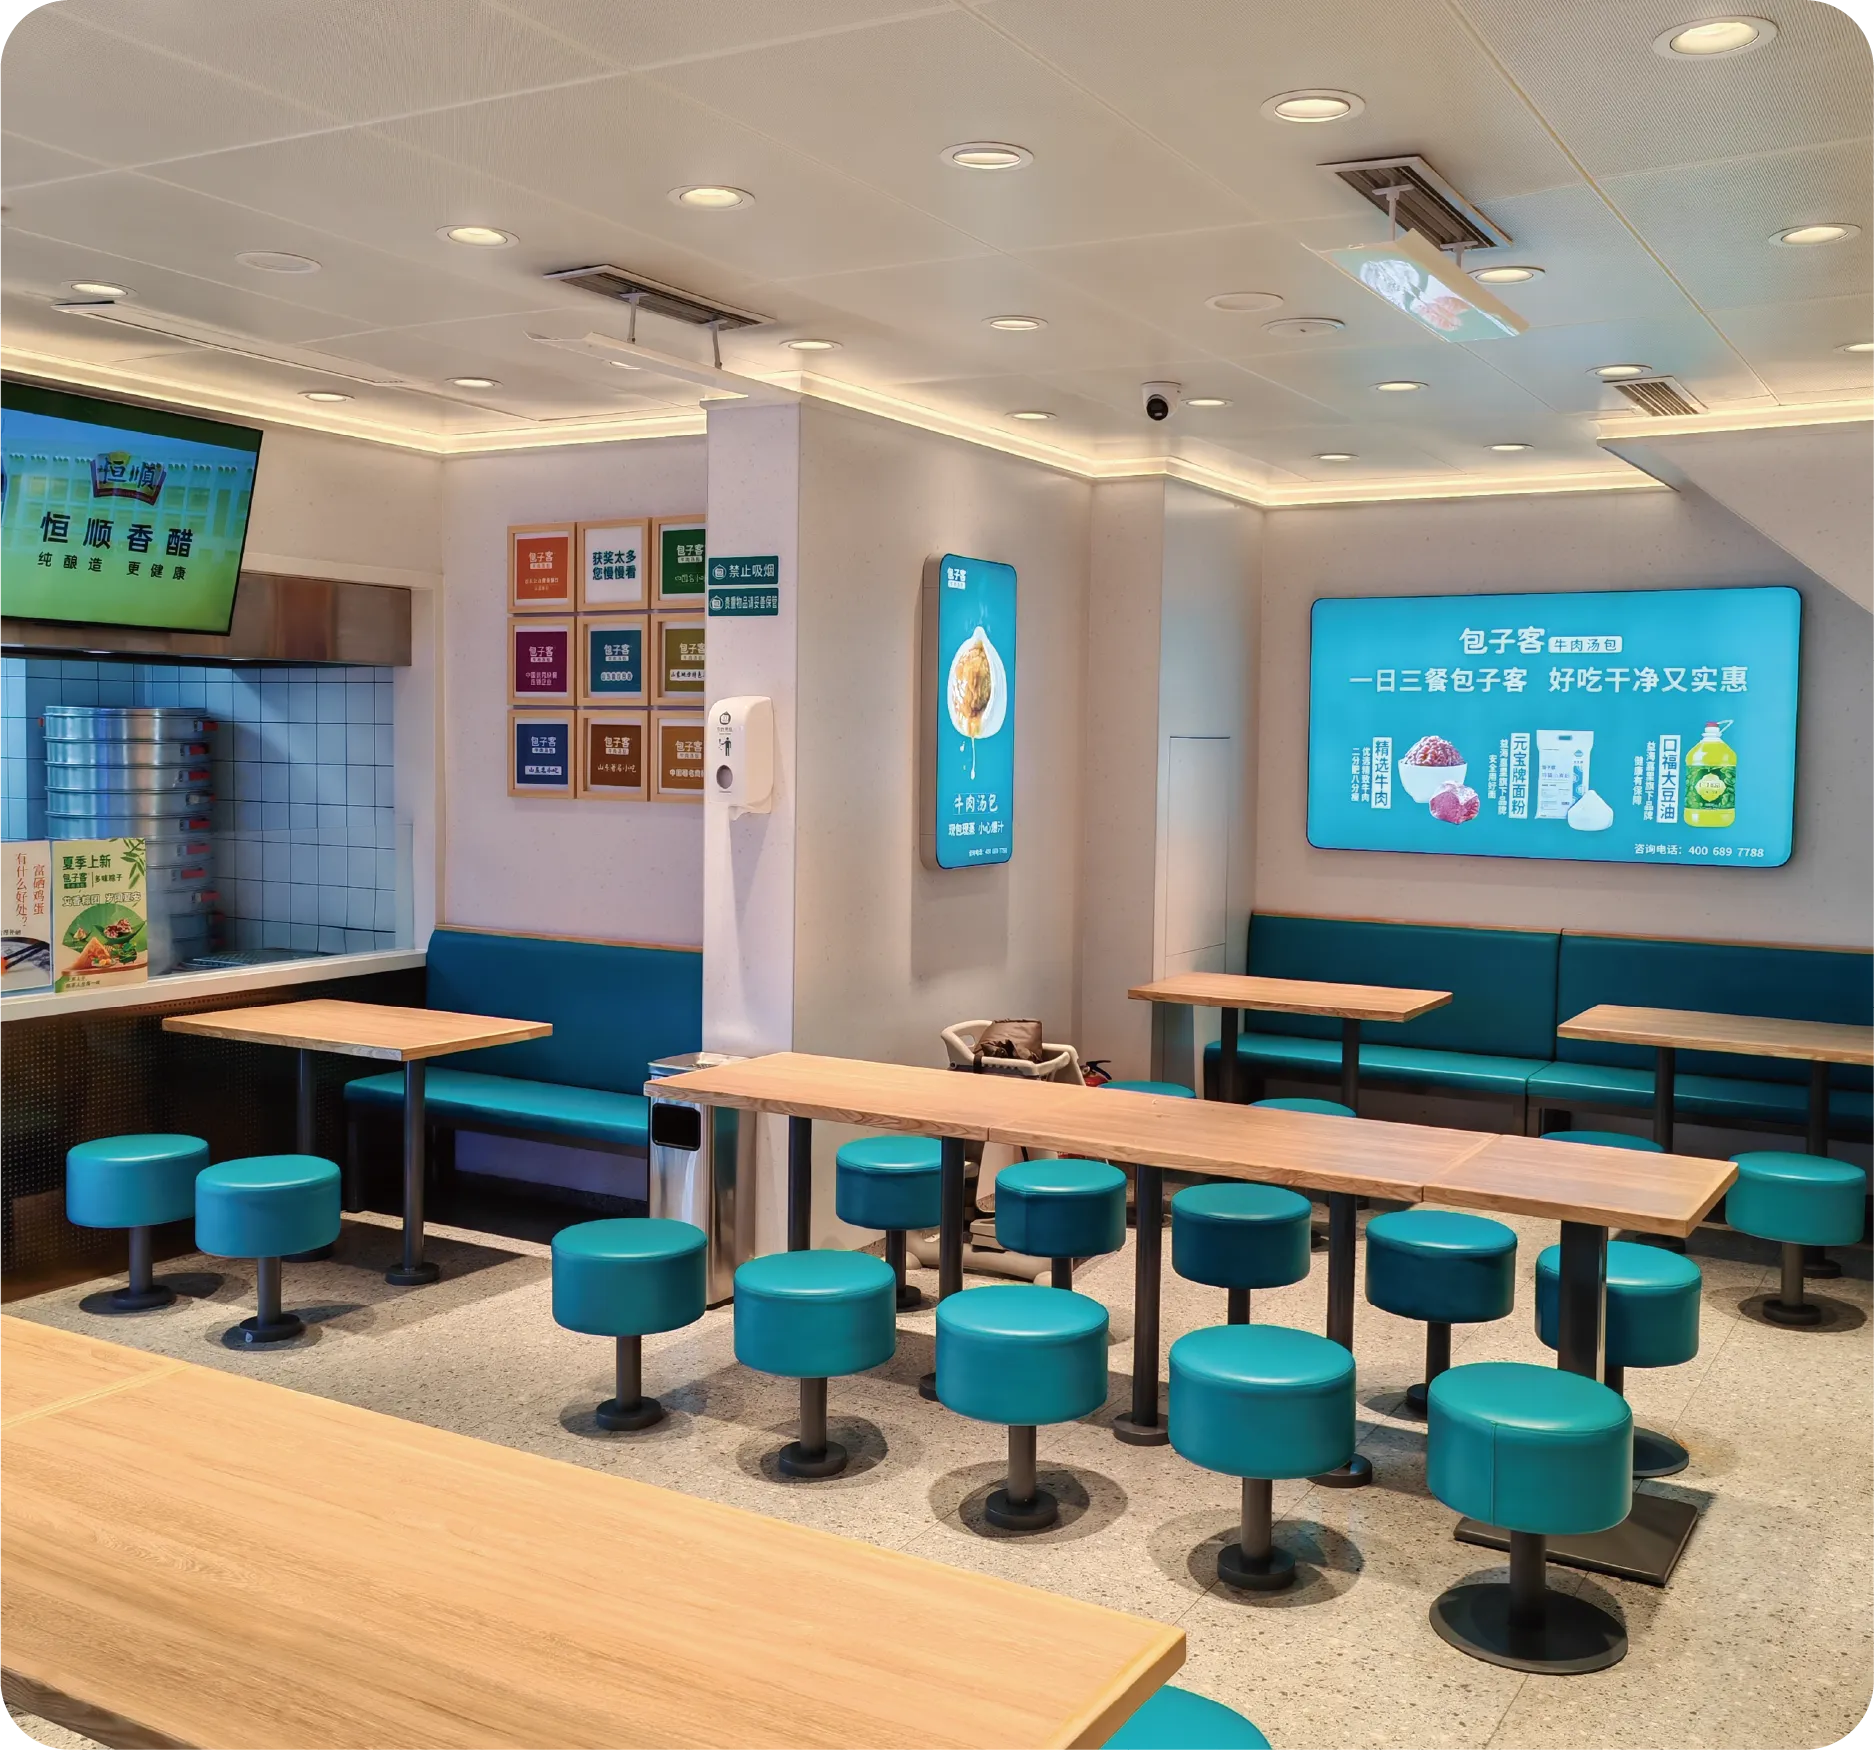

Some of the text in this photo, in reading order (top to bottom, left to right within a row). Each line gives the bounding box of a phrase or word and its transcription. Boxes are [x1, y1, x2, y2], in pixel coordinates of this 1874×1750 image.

[40, 511, 194, 558] 恒顺香醋
[38, 551, 187, 580] 纯酿造 更健康
[592, 549, 637, 566] 获奖太多
[728, 563, 775, 578] 禁止吸烟
[592, 565, 637, 581] 您慢慢看
[1458, 626, 1617, 655] 包子客 牛肉汤包
[1349, 665, 1749, 693] 一日三餐包子客 好吃干净又实惠
[1374, 740, 1390, 807] 精选牛肉
[1511, 735, 1528, 816] 元宝牌面粉
[1660, 738, 1678, 820] 口福大豆油
[953, 793, 998, 815] 牛肉汤包
[62, 854, 111, 871] 夏季上新
[1688, 845, 1708, 856] 400
[1712, 846, 1733, 857] 689
[1737, 847, 1765, 858] 7788
[33, 864, 46, 916] 富硒鸡蛋
